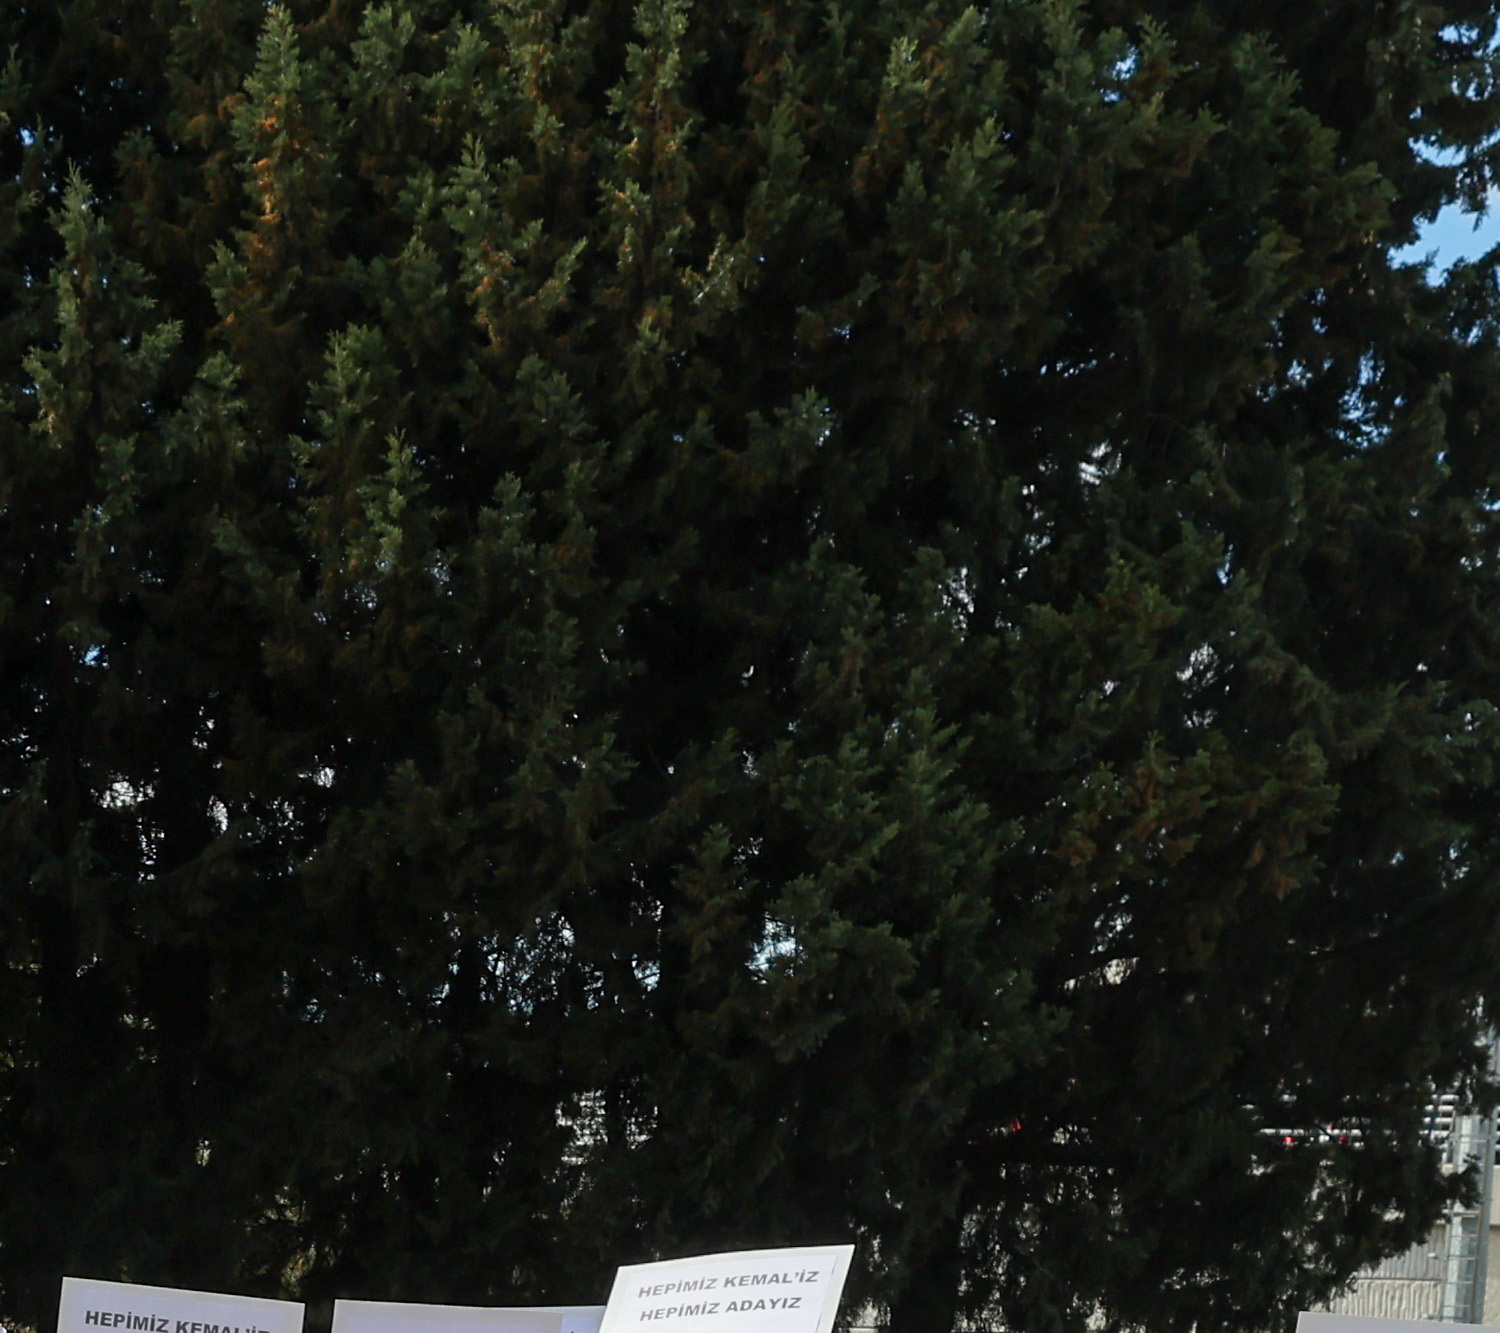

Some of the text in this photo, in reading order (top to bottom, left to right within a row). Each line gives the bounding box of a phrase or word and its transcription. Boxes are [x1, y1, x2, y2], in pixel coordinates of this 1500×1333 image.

[638, 1270, 820, 1298] HEPİMİZ KEMAL'İZ
[85, 1310, 169, 1333] HEPİMİZ
[640, 1297, 802, 1322] HEPİMİZ ADAYIZ
